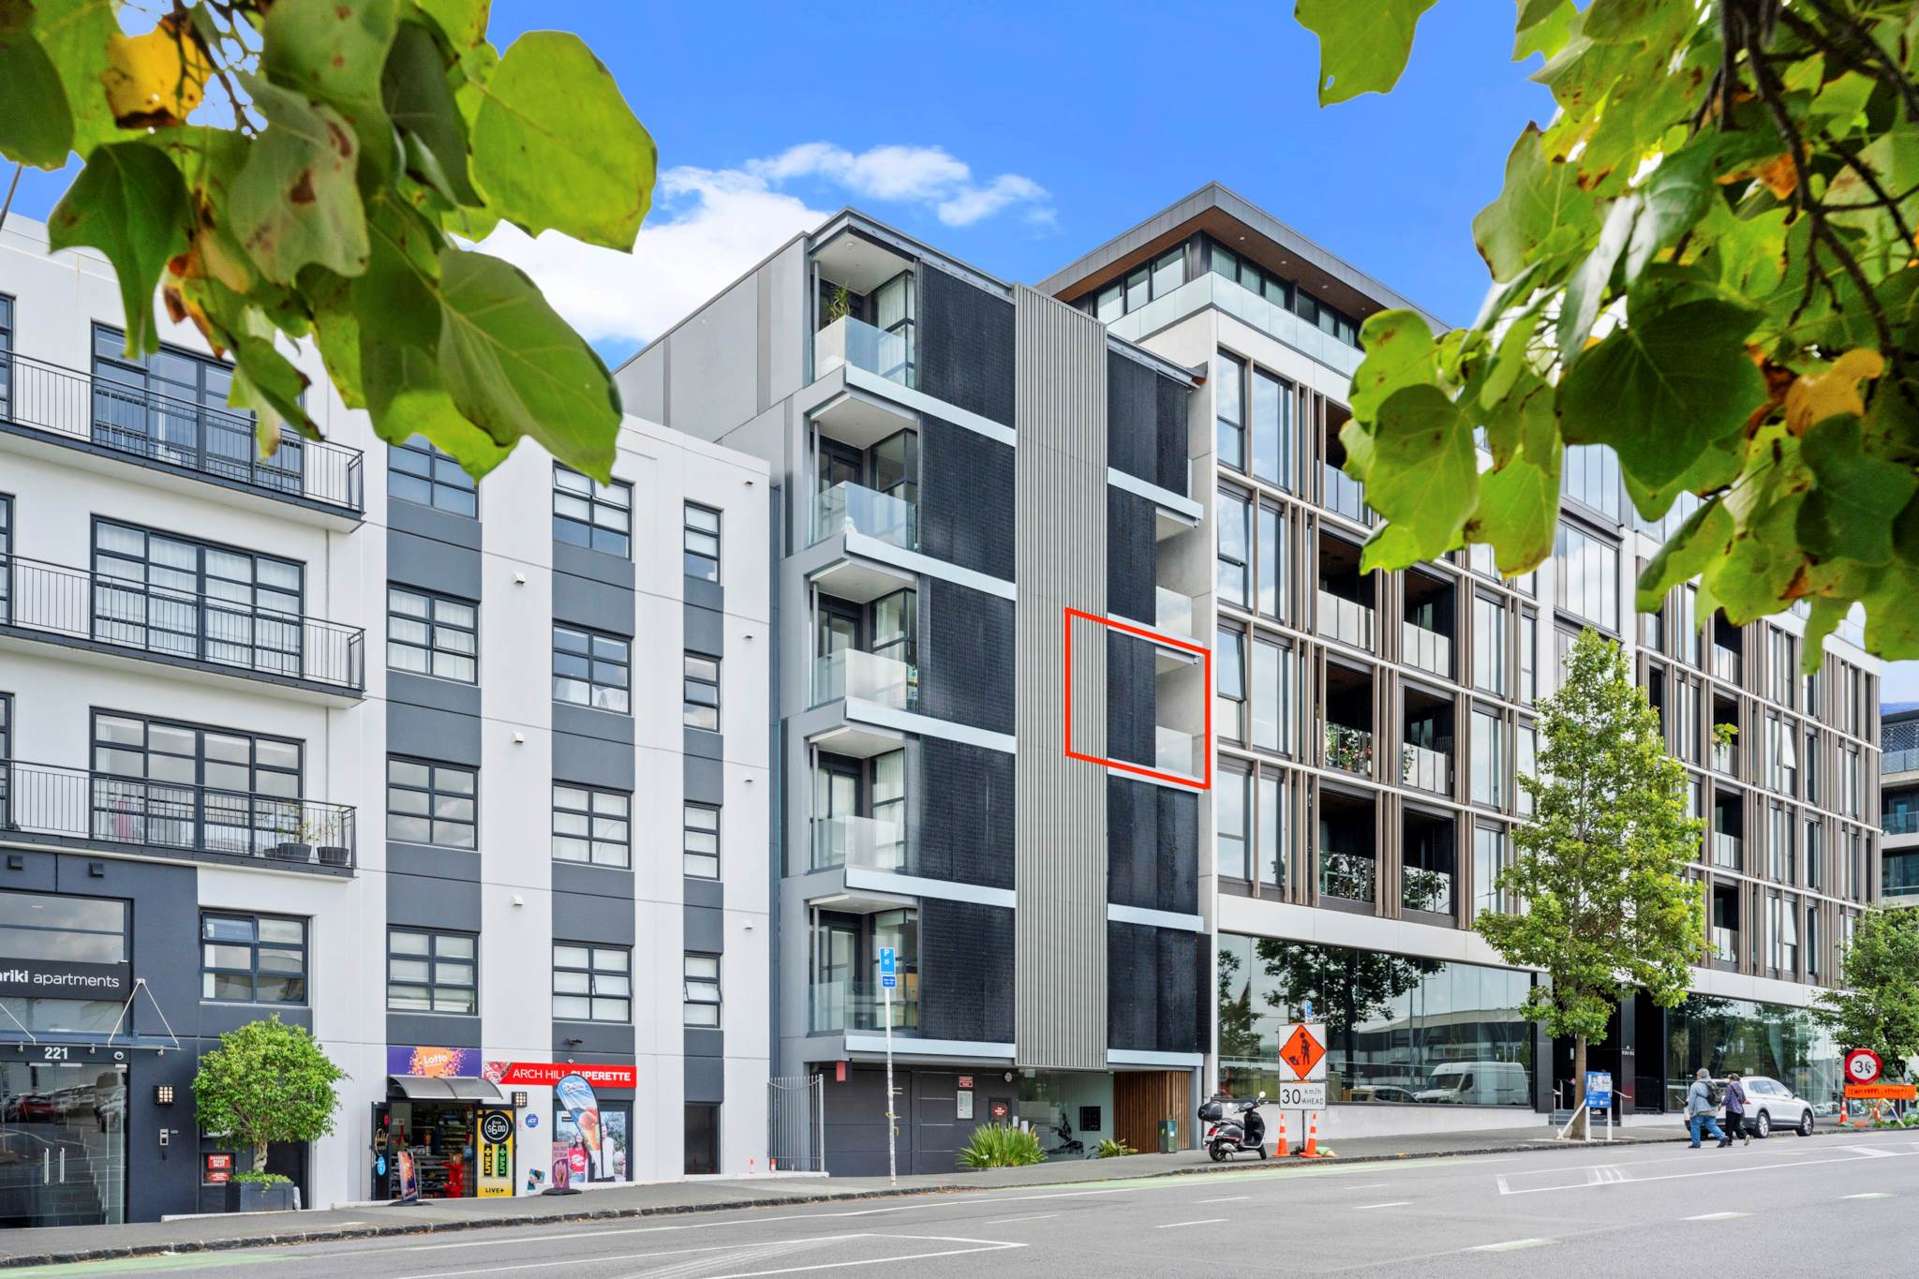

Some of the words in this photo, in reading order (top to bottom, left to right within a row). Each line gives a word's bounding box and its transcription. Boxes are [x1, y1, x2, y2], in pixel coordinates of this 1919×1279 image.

[33, 973, 120, 988] apartments
[44, 1046, 69, 1060] 221
[423, 1054, 449, 1067] Lotto
[512, 1068, 543, 1079] ARCH
[570, 1070, 631, 1081] PERETTE
[1282, 1088, 1301, 1105] 30
